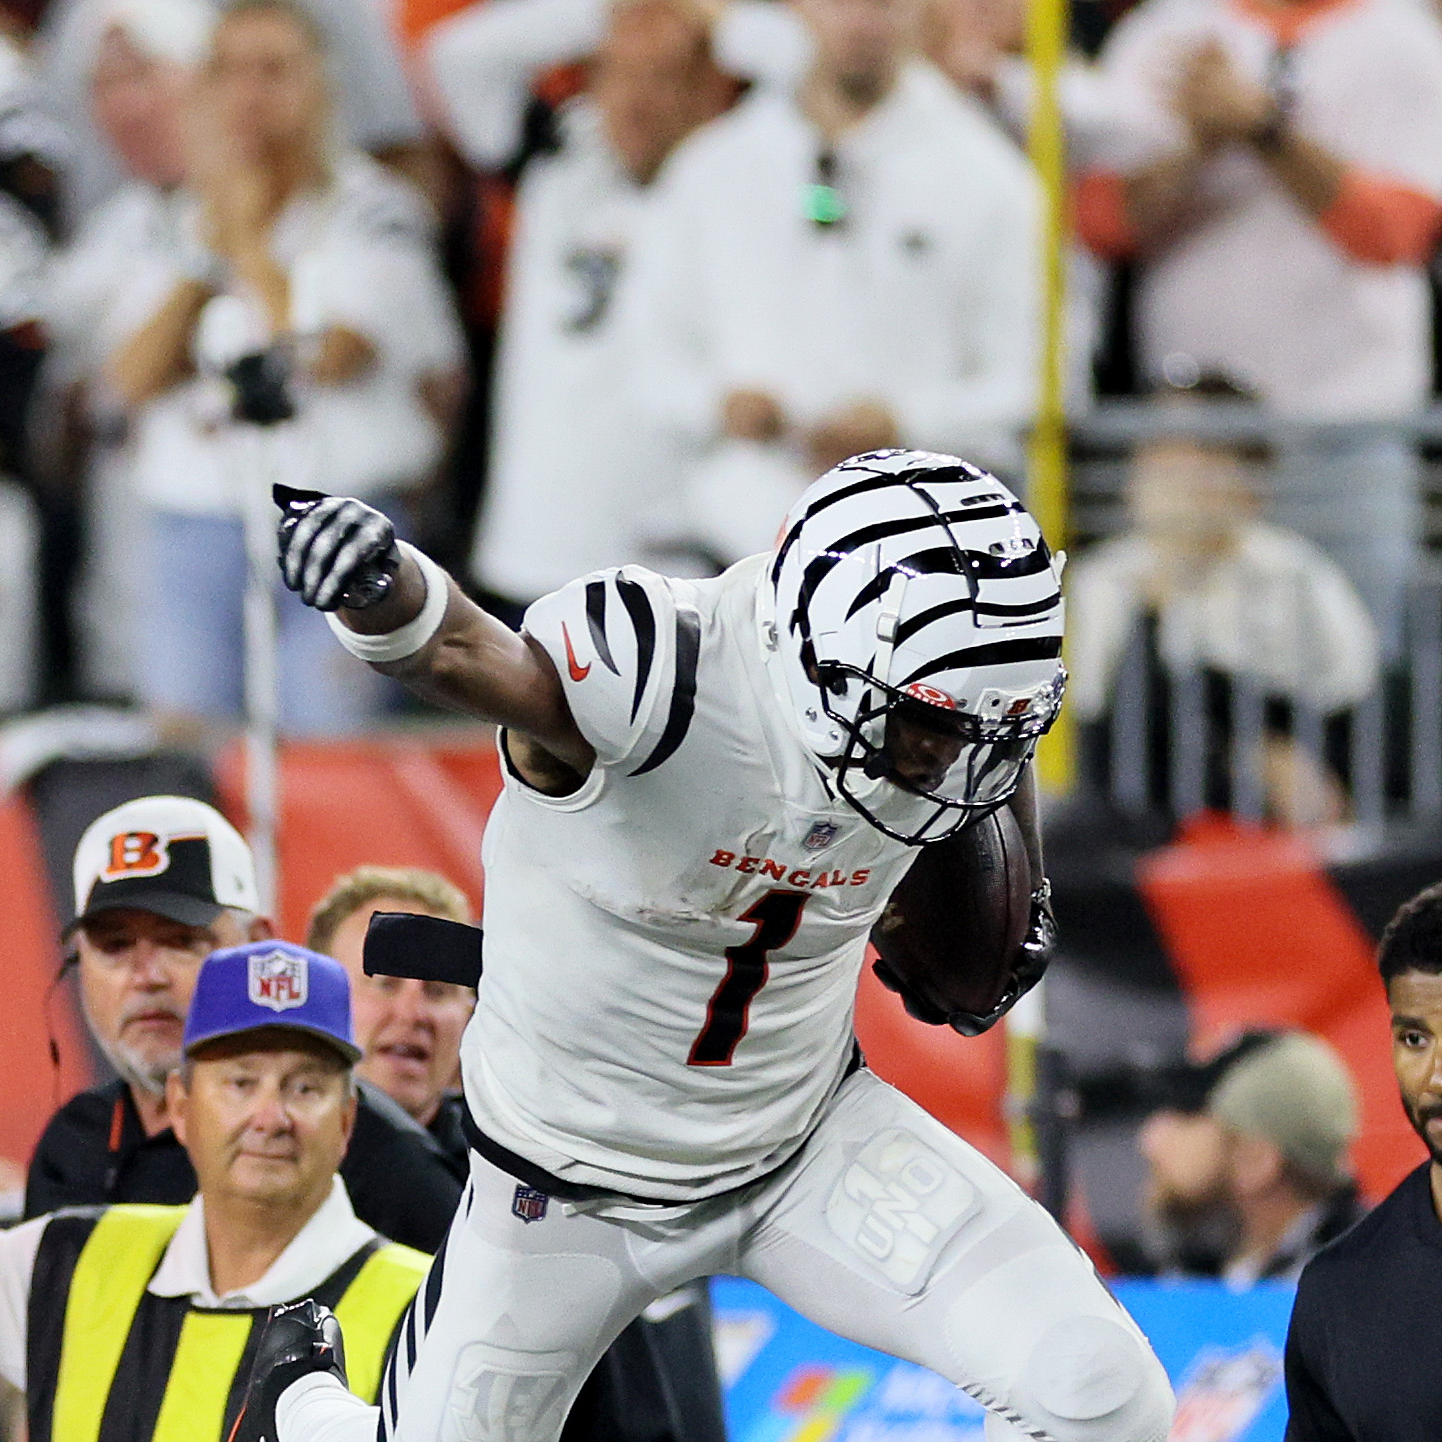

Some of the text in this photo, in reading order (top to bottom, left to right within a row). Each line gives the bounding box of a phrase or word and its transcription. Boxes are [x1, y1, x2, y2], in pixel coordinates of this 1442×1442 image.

[106, 831, 161, 874] B
[709, 849, 872, 890] BENGALS
[259, 975, 302, 999] NFL
[686, 888, 813, 1067] 1
[857, 1156, 945, 1263] UNO
